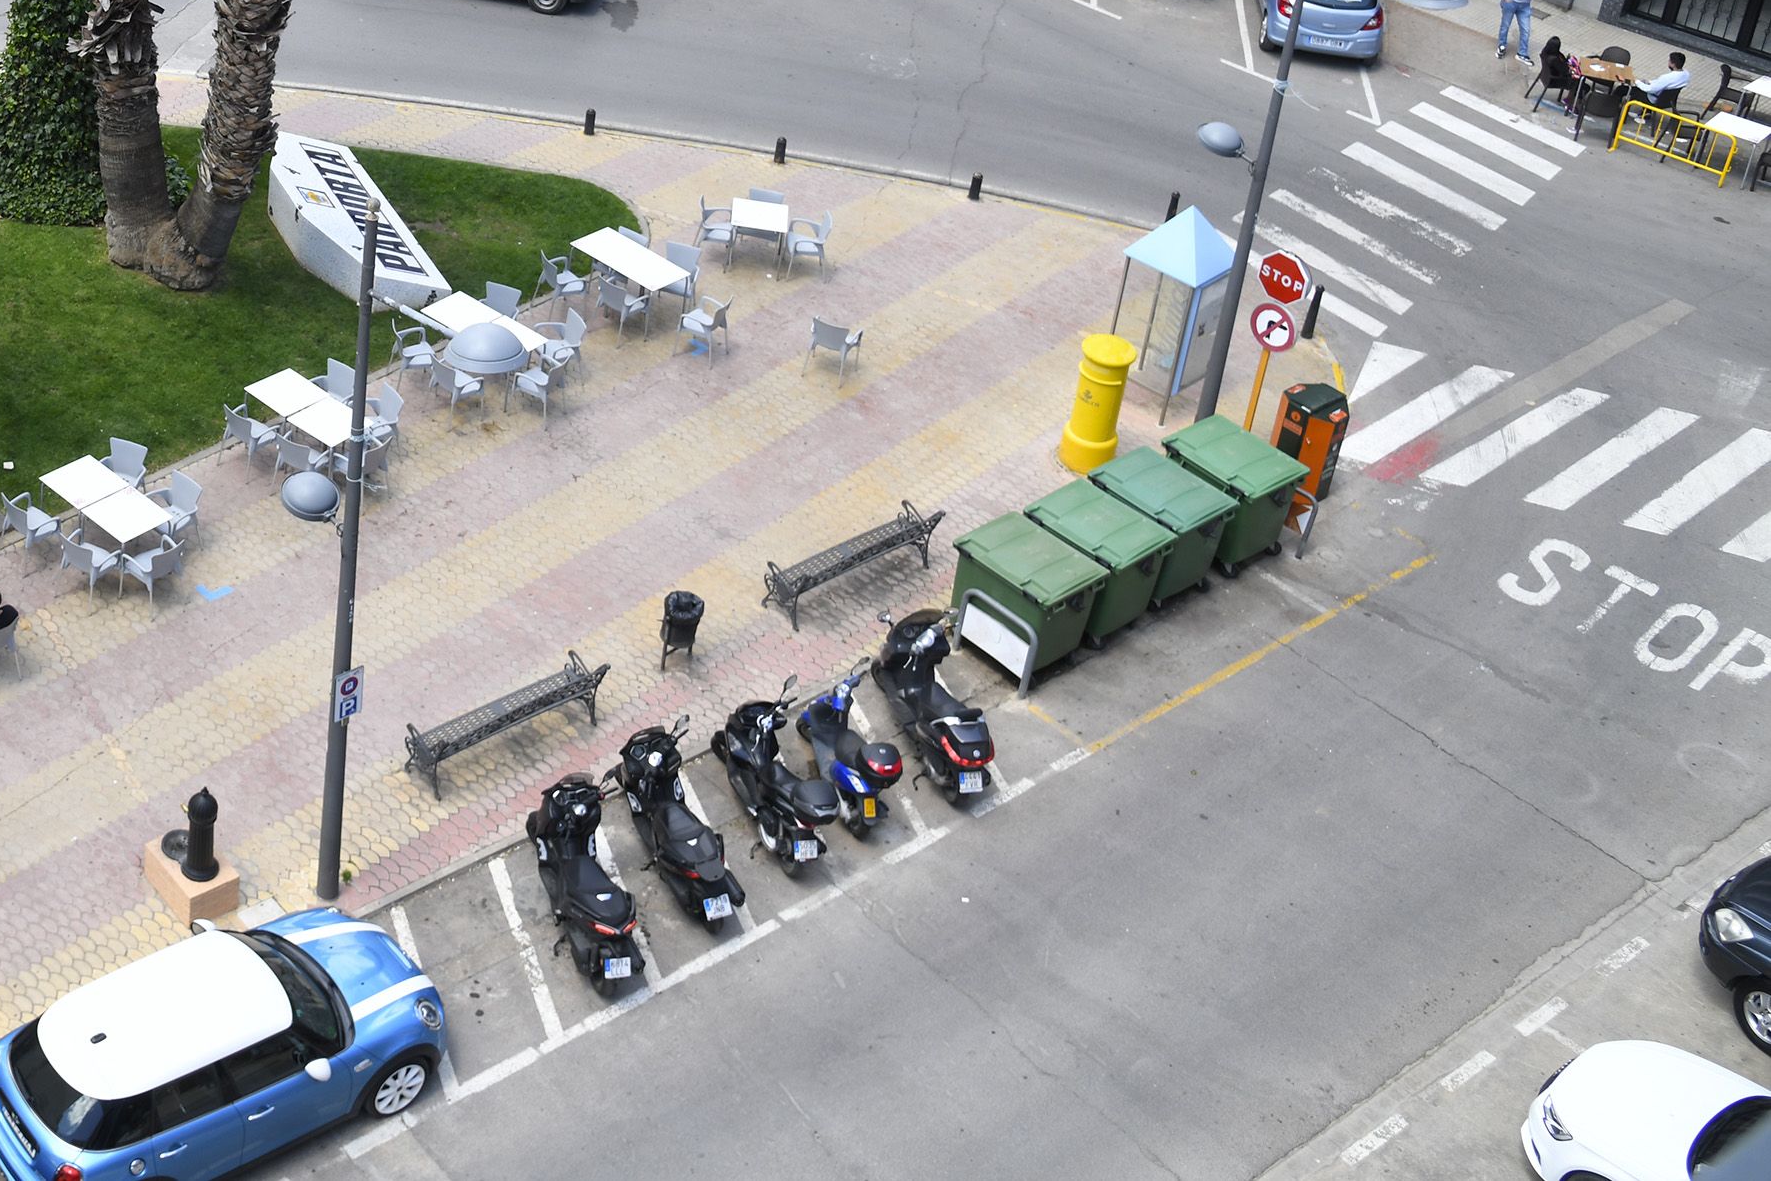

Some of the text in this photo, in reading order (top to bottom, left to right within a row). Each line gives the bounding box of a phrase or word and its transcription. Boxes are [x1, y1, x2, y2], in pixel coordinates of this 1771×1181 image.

[305, 149, 425, 275] PAIPORTA
[1261, 264, 1303, 292] STOP
[1497, 538, 1771, 691] STOP
[342, 699, 355, 717] P
